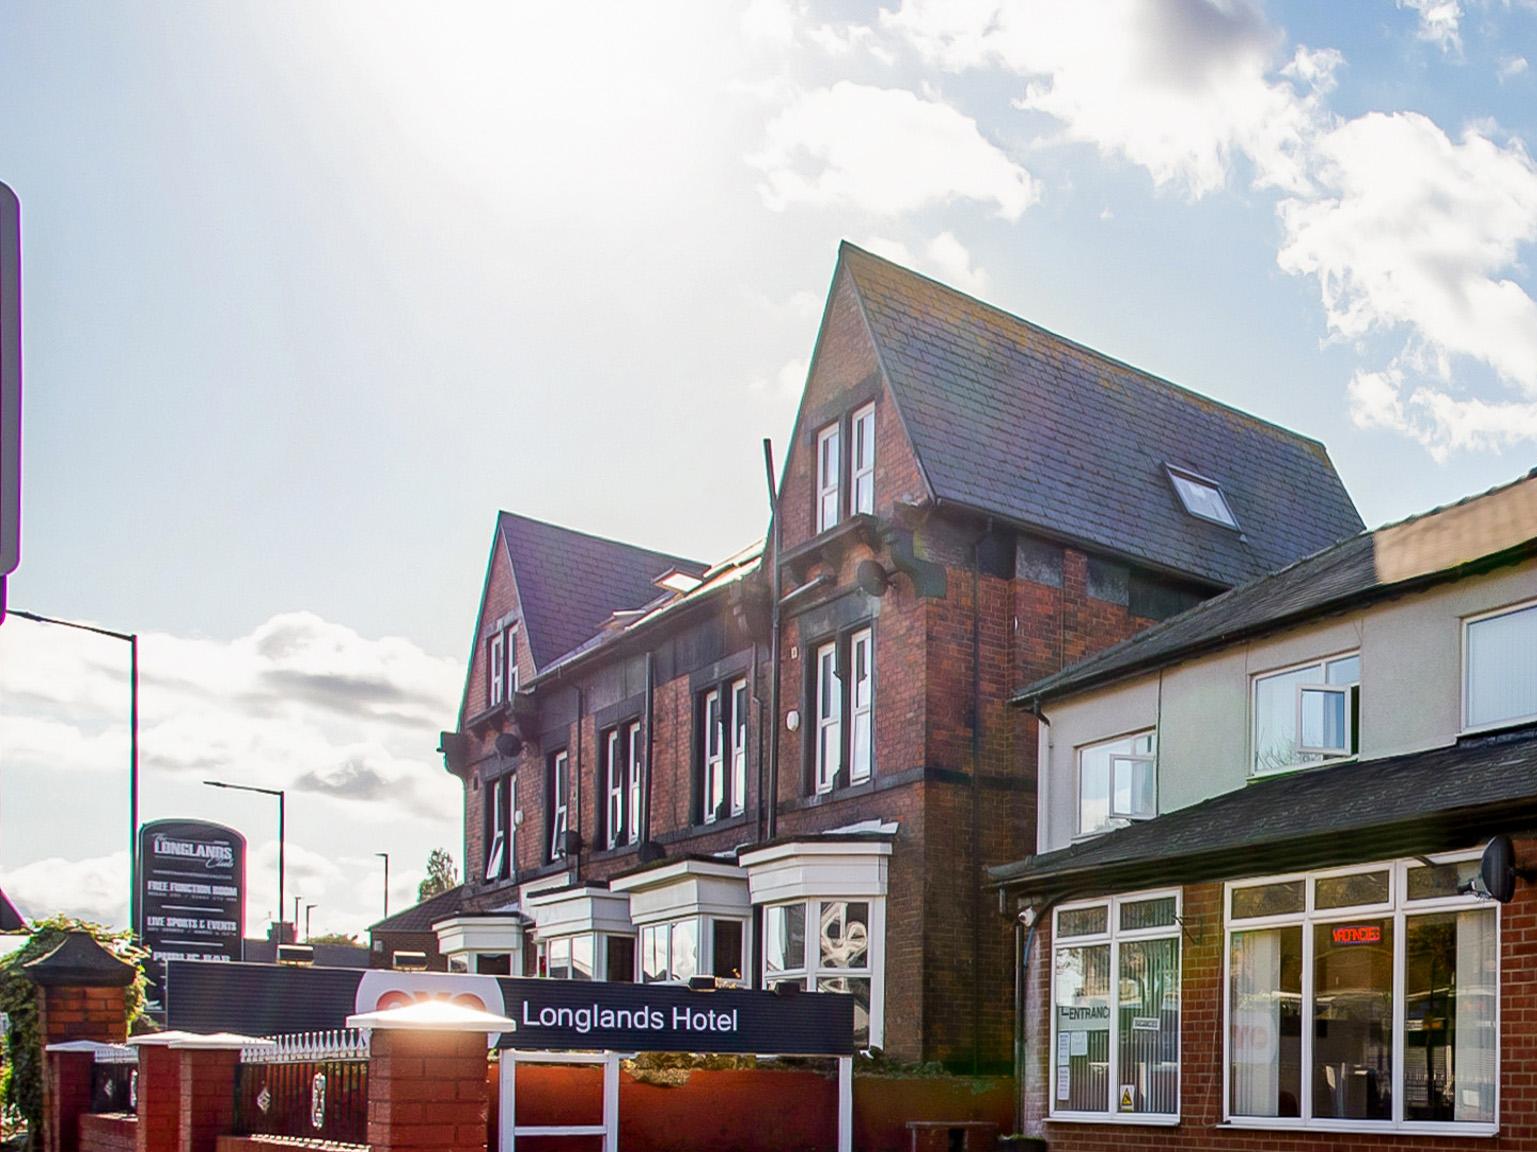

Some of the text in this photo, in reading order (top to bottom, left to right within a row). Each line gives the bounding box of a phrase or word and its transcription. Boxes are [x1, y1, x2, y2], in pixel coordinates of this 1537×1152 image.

[154, 838, 232, 859] LONGLANDS
[147, 880, 168, 892] FREE
[169, 882, 211, 895] FUNCTION
[147, 916, 165, 926] LIVE
[166, 917, 197, 929] SPORTS
[207, 920, 237, 932] EVENTS
[523, 1000, 738, 1033] Longlands Hotel
